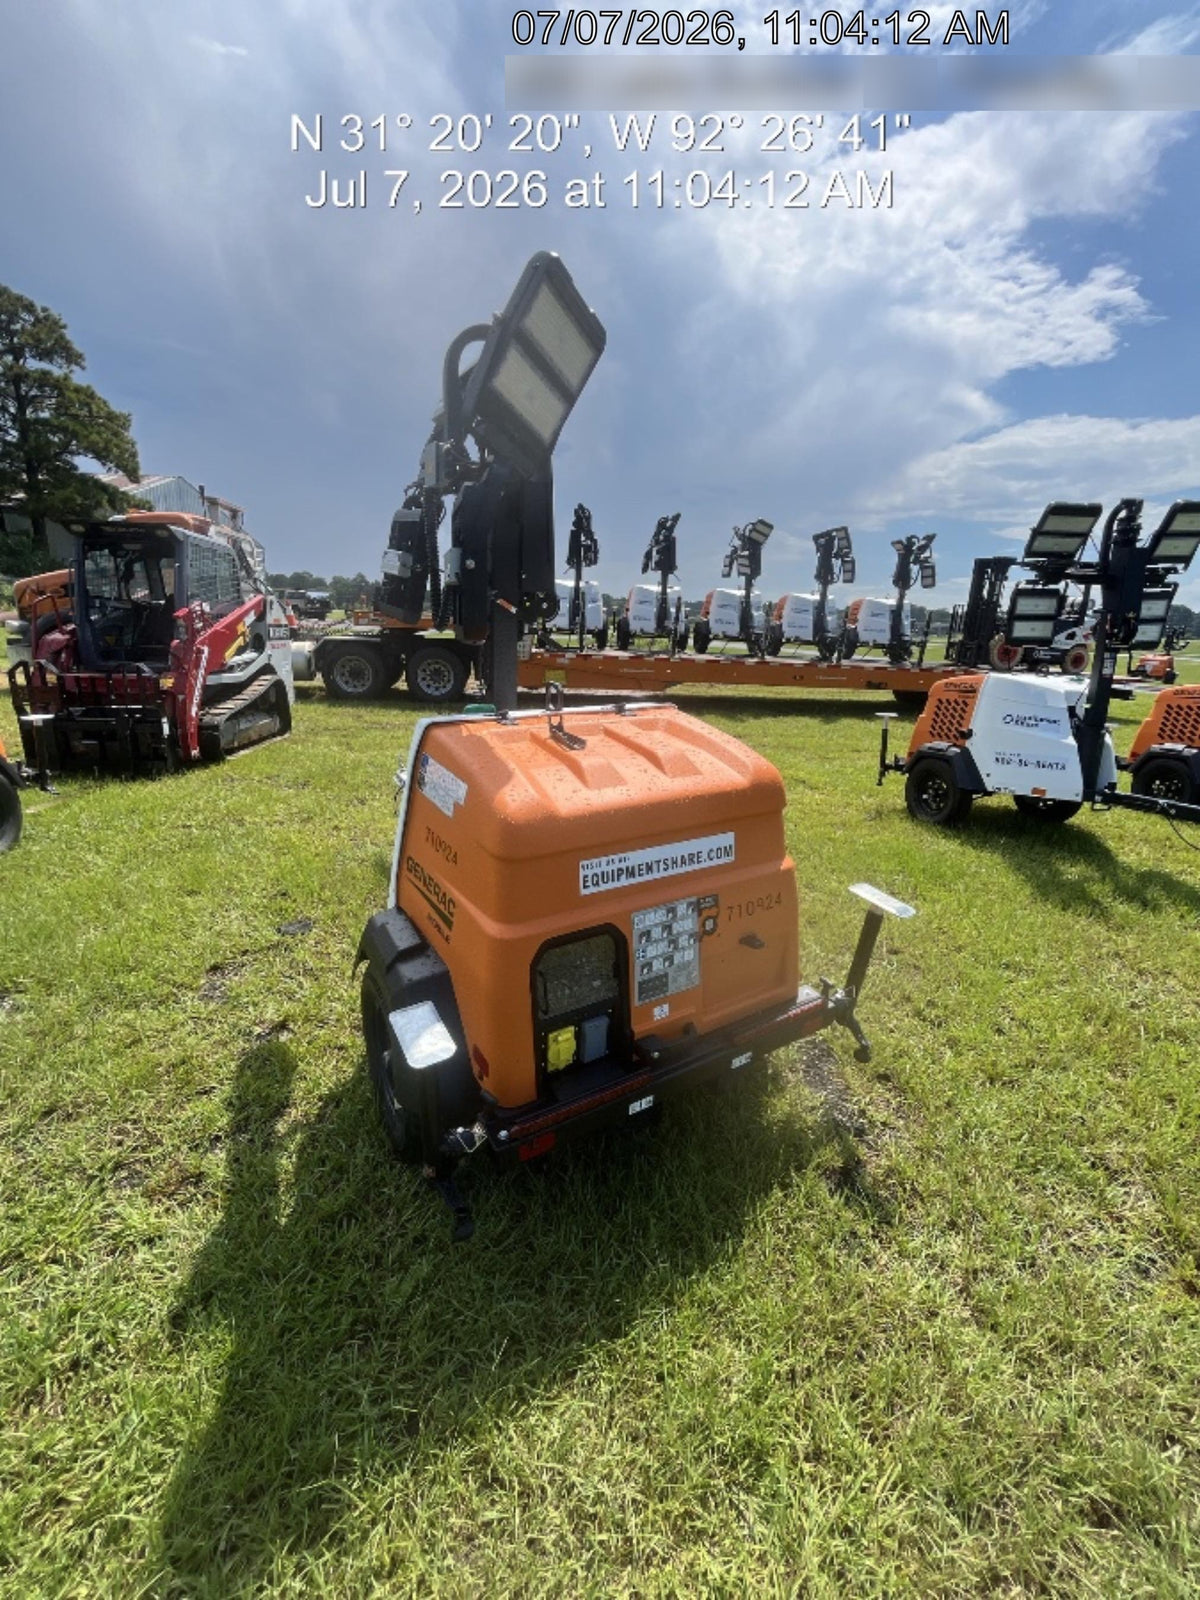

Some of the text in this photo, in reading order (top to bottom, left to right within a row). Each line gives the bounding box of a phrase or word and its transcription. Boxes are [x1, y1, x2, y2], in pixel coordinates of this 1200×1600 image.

[425, 825, 458, 866] 710924
[582, 844, 734, 890] EQUIPMENTSHARE.COM
[406, 855, 457, 919] GENERAC
[727, 892, 782, 922] 710924
